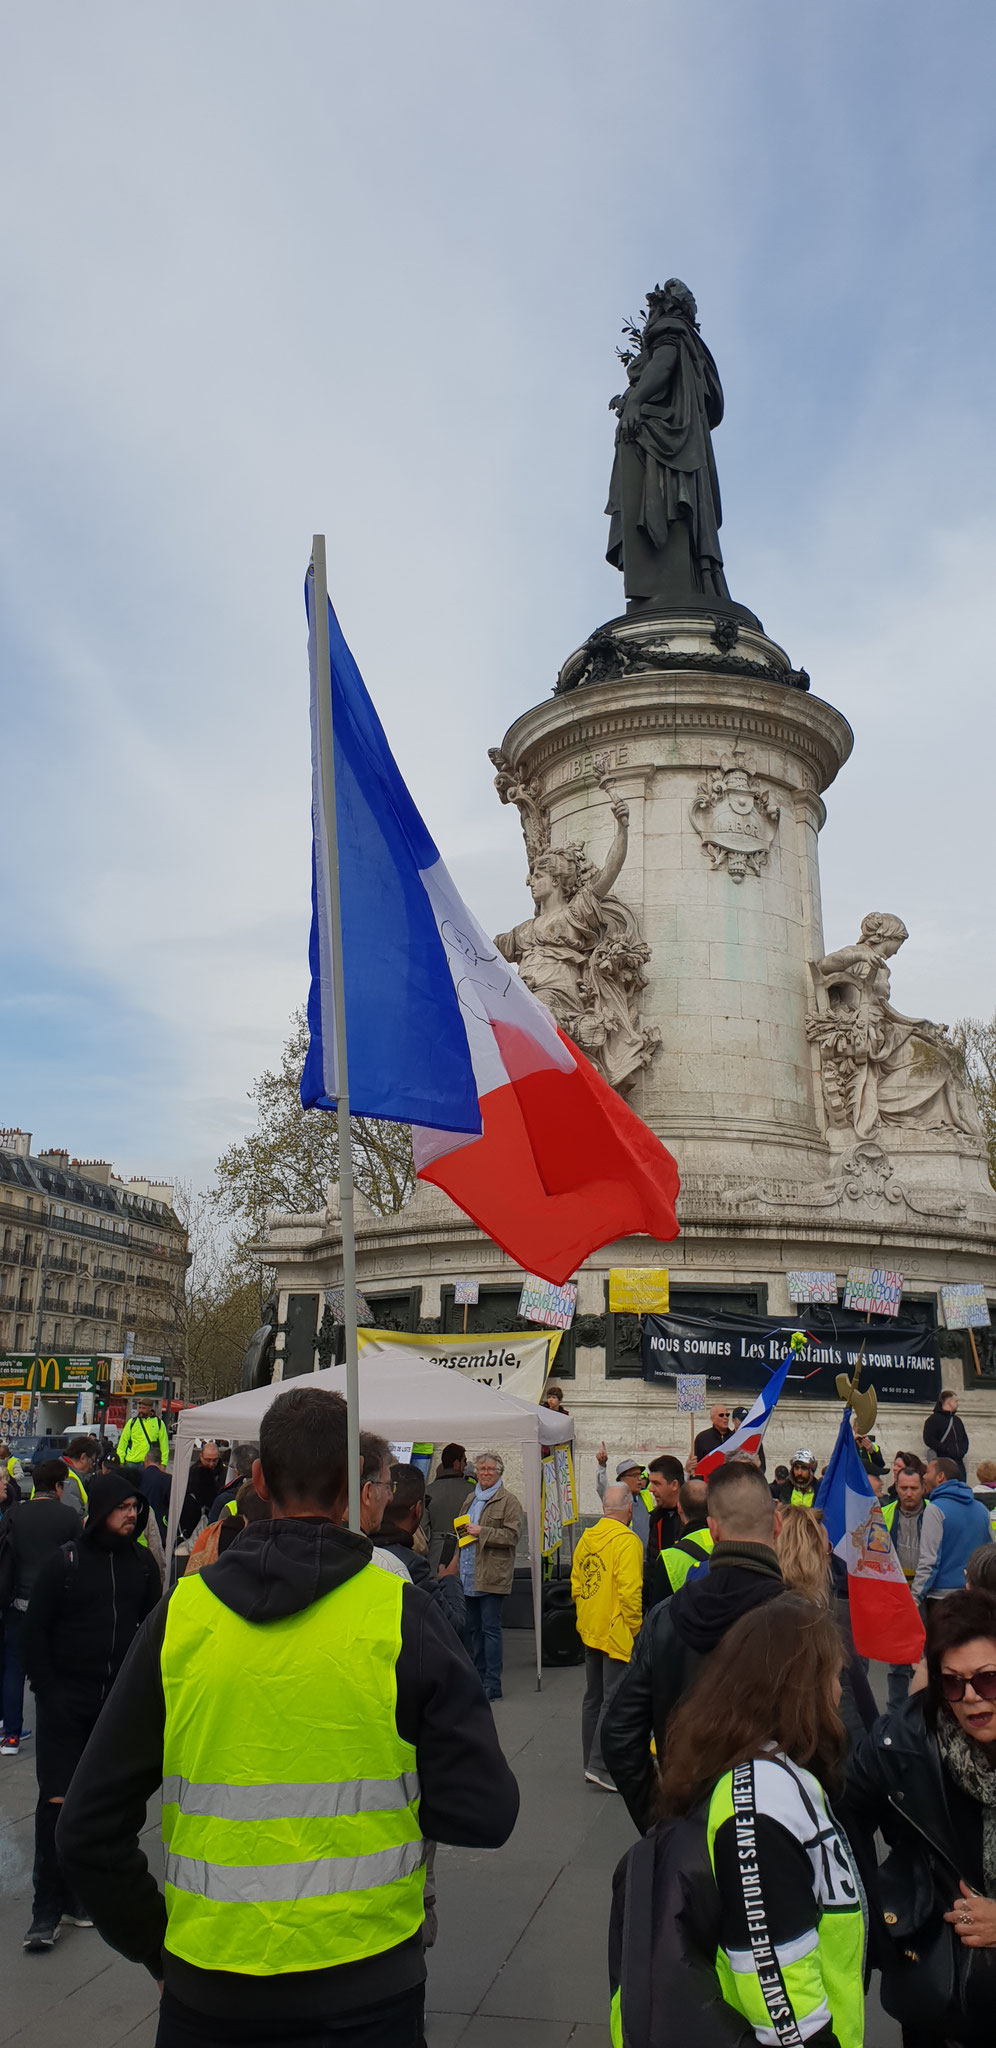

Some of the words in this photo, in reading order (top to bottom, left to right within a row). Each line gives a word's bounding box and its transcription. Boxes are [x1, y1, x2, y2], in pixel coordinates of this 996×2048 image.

[717, 820, 759, 837] LABOR
[530, 1306, 572, 1329] CLIMAT
[855, 1296, 899, 1316] CLIMAT
[650, 1336, 680, 1352] NOUS
[683, 1339, 731, 1356] SOMMES
[740, 1337, 765, 1359] Les
[847, 1351, 867, 1366] UNS
[869, 1353, 892, 1368] POUR
[894, 1355, 905, 1369] LA
[906, 1356, 935, 1371] FRANCE
[733, 1785, 754, 1814] THE
[736, 1817, 757, 1860] SAVE
[740, 1863, 768, 1932] FUTURE
[750, 1934, 775, 1970] THE
[759, 1972, 792, 2020] SAVE
[775, 2020, 804, 2048] RE
